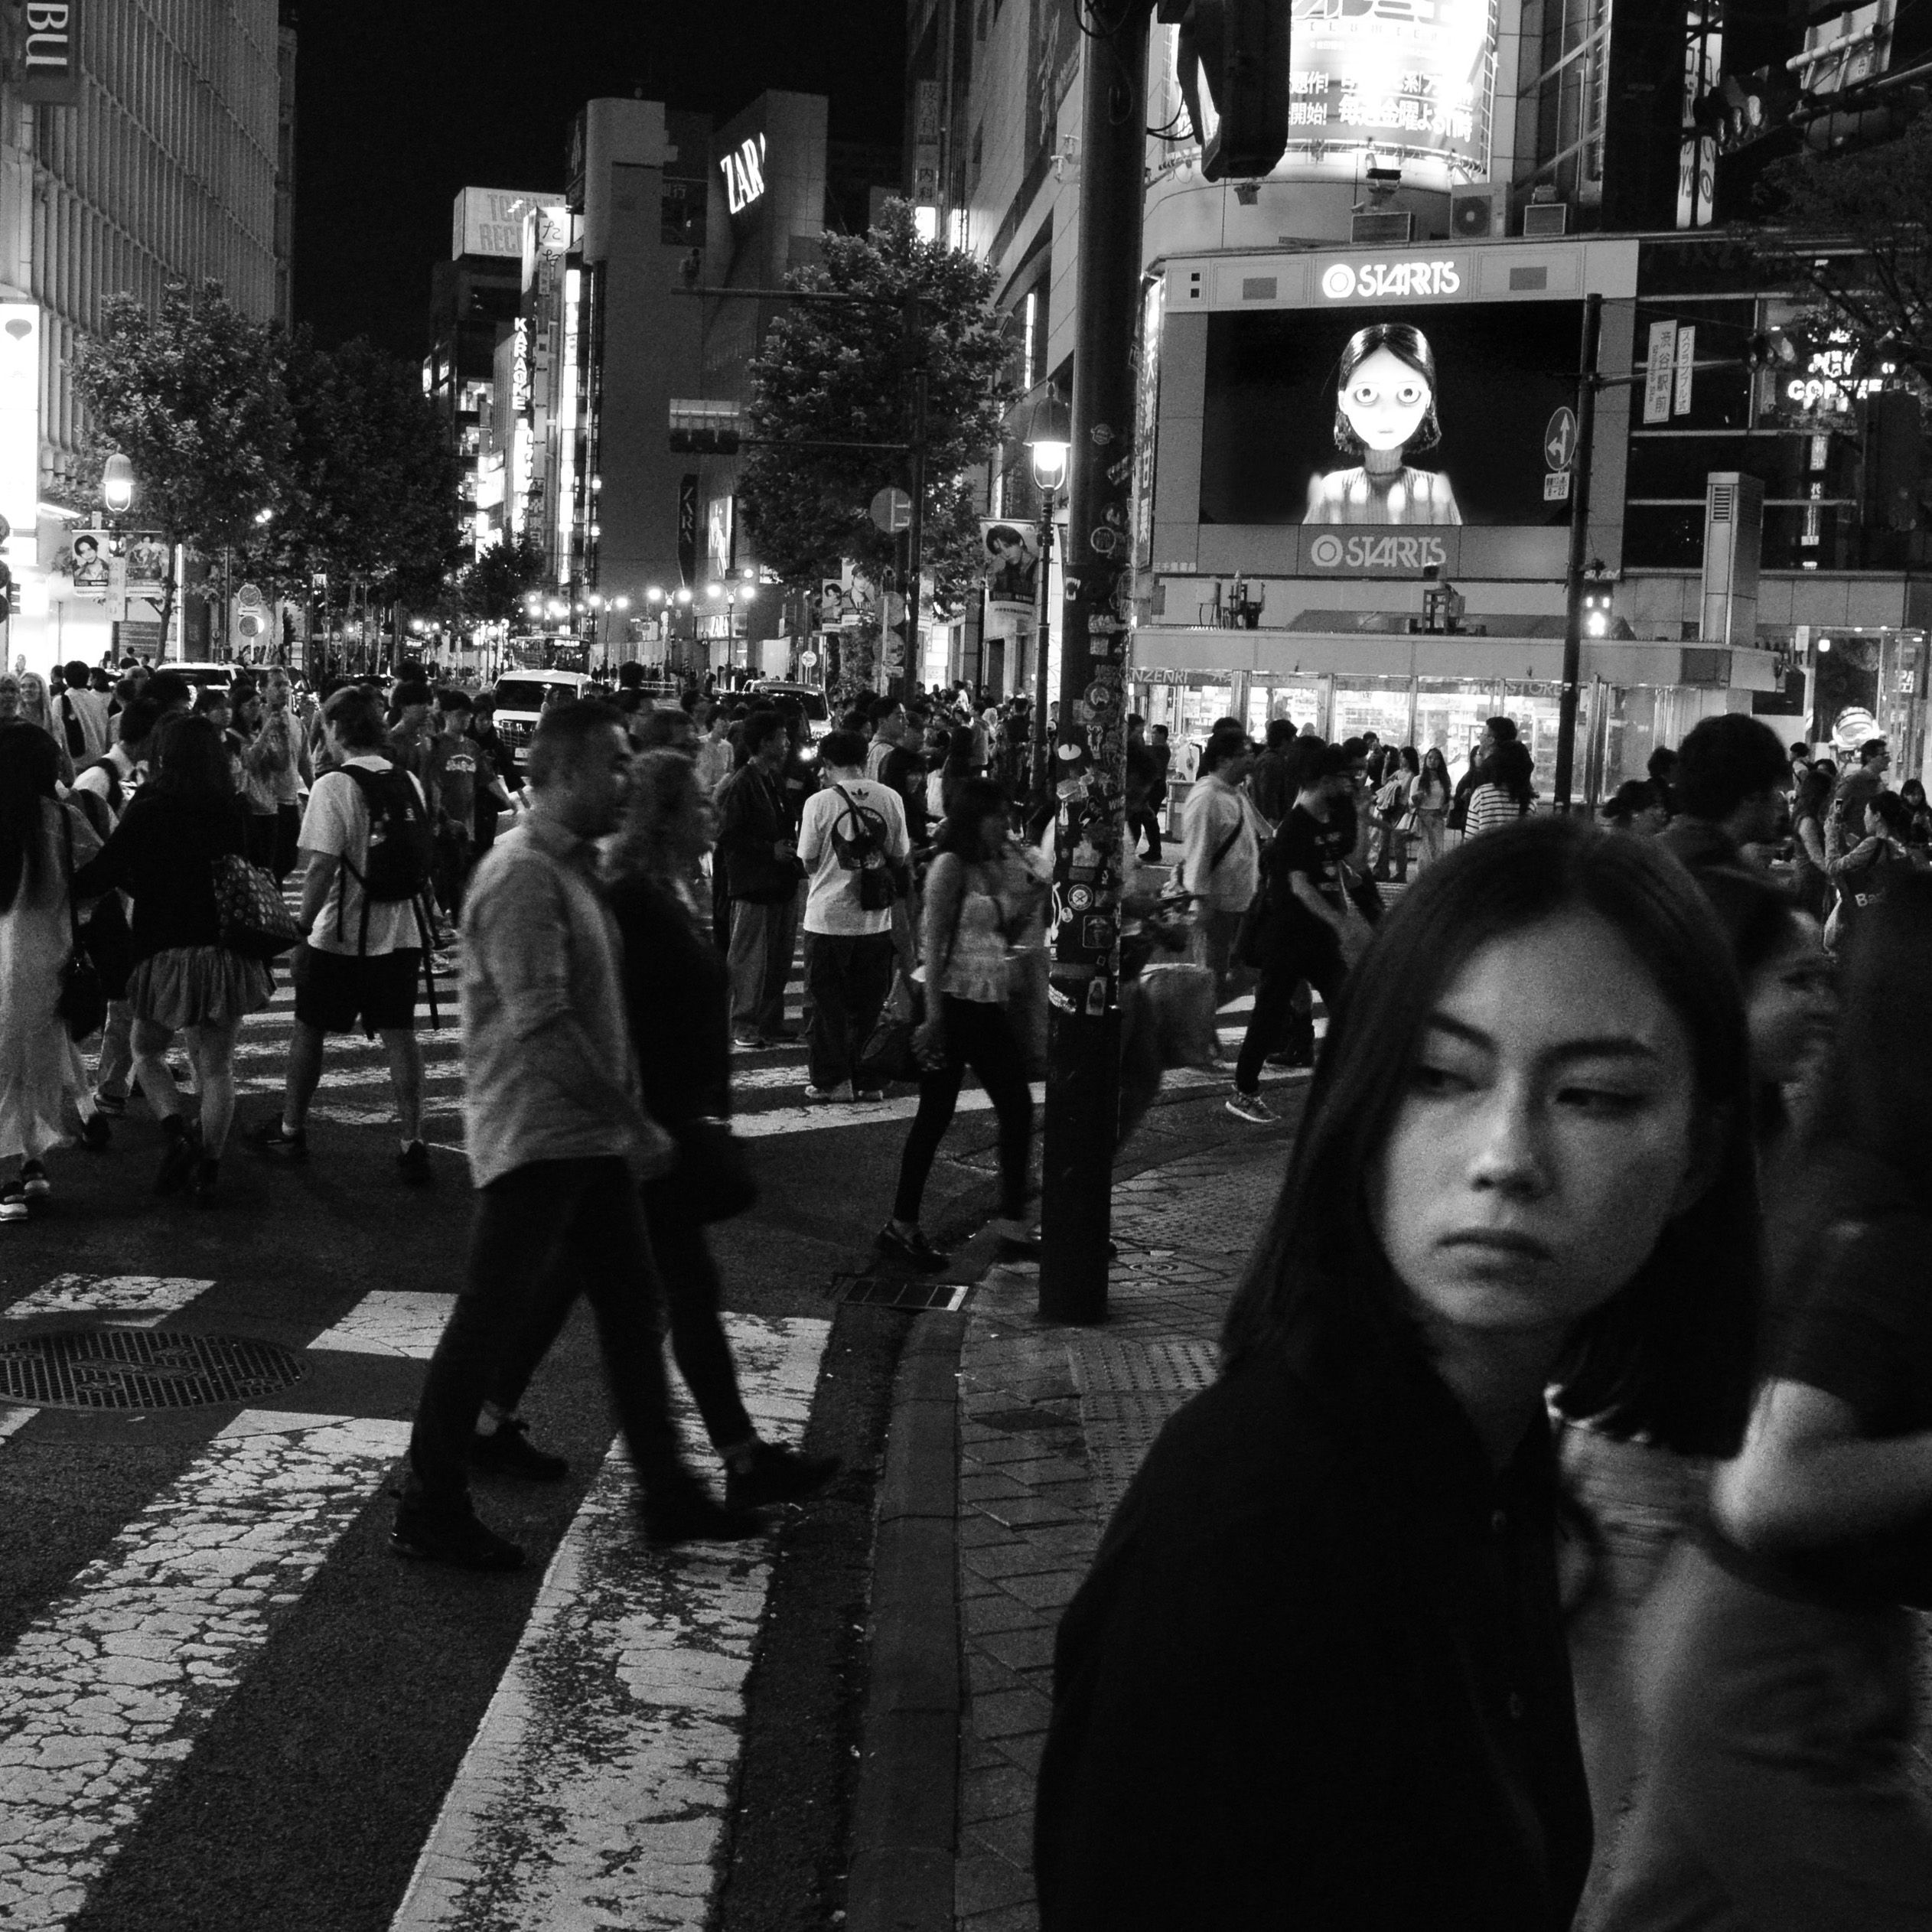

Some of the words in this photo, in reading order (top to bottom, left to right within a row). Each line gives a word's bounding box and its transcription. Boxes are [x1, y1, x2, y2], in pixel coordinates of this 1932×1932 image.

[26, 3, 69, 67] BU
[1289, 103, 1328, 125] 開始!
[480, 223, 523, 252] REC
[512, 318, 528, 411] KARAOKE
[1655, 331, 1671, 413] 渋谷駅前
[681, 487, 694, 543] ZARA
